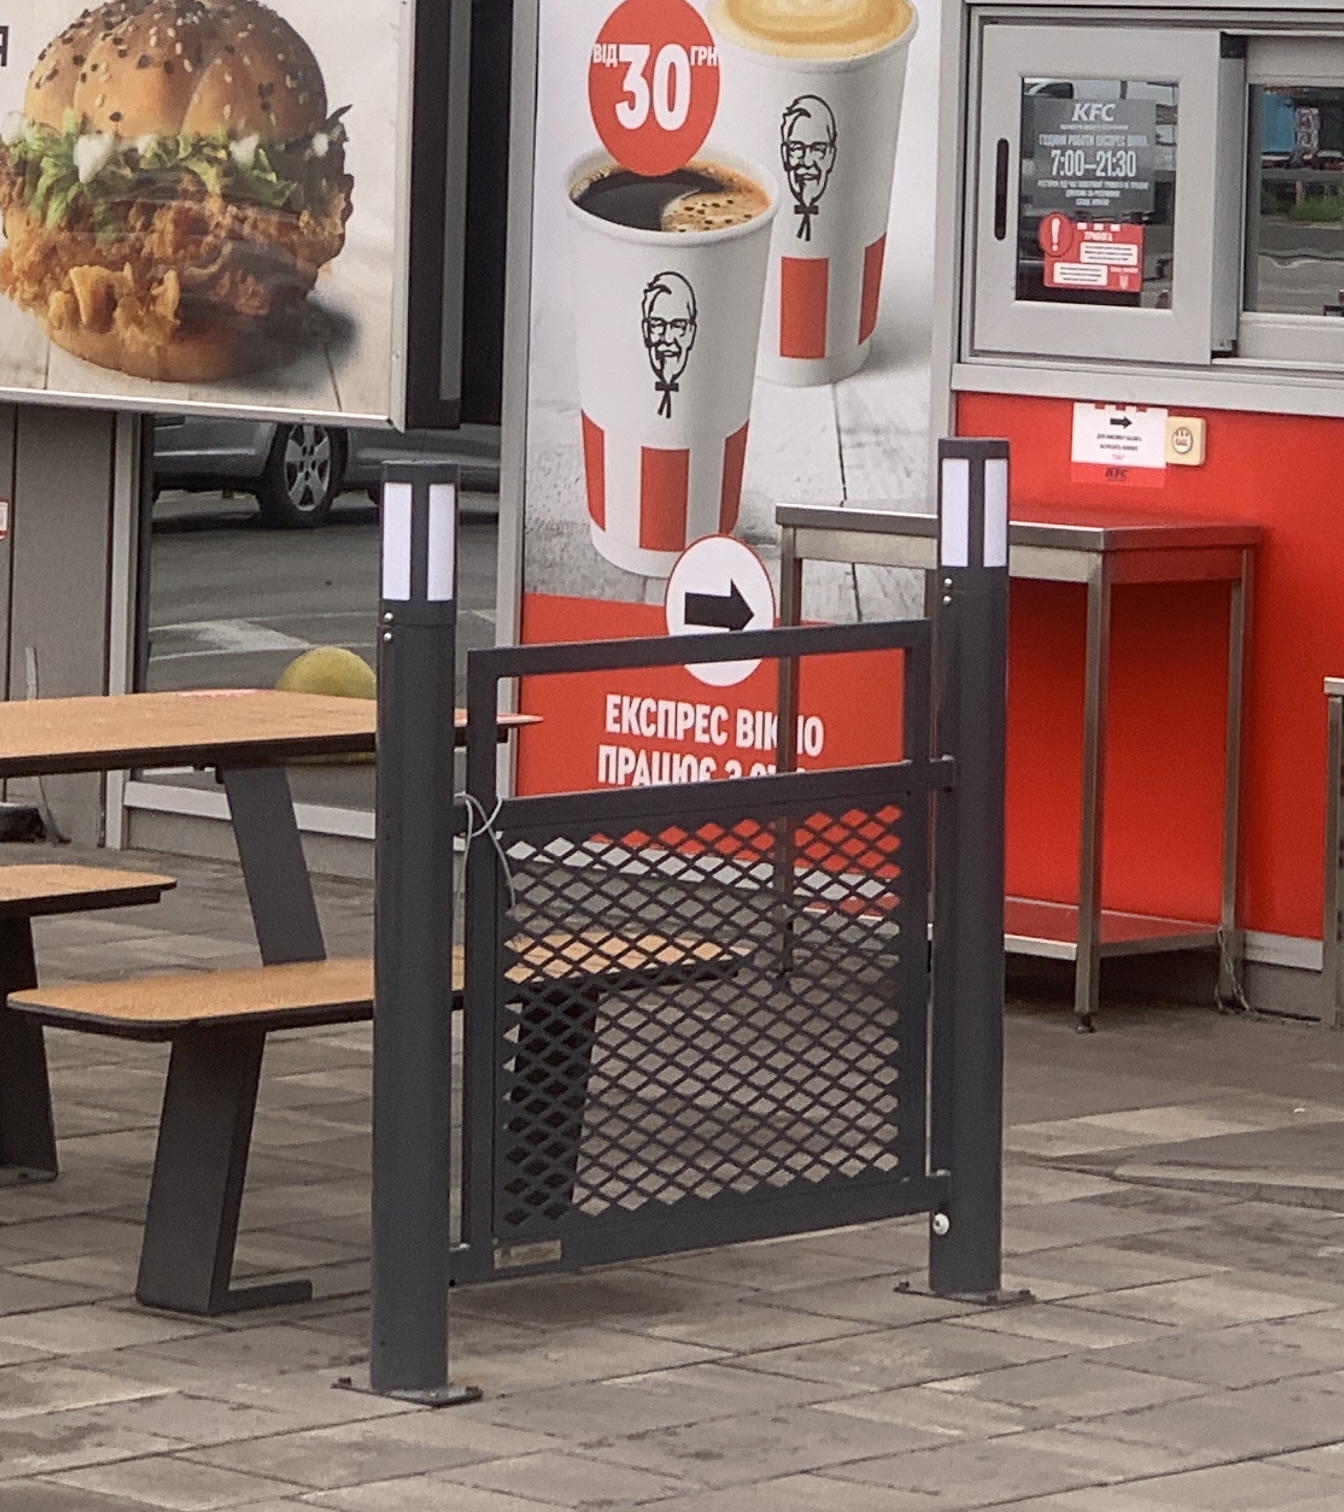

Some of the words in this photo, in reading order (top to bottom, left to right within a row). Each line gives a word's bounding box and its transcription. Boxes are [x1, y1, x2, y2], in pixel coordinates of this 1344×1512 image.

[592, 43, 618, 68] ВІД
[615, 43, 691, 131] 30
[690, 43, 719, 67] ГРН
[1072, 103, 1116, 122] KFC
[606, 693, 729, 746] ЕКСПРЕС
